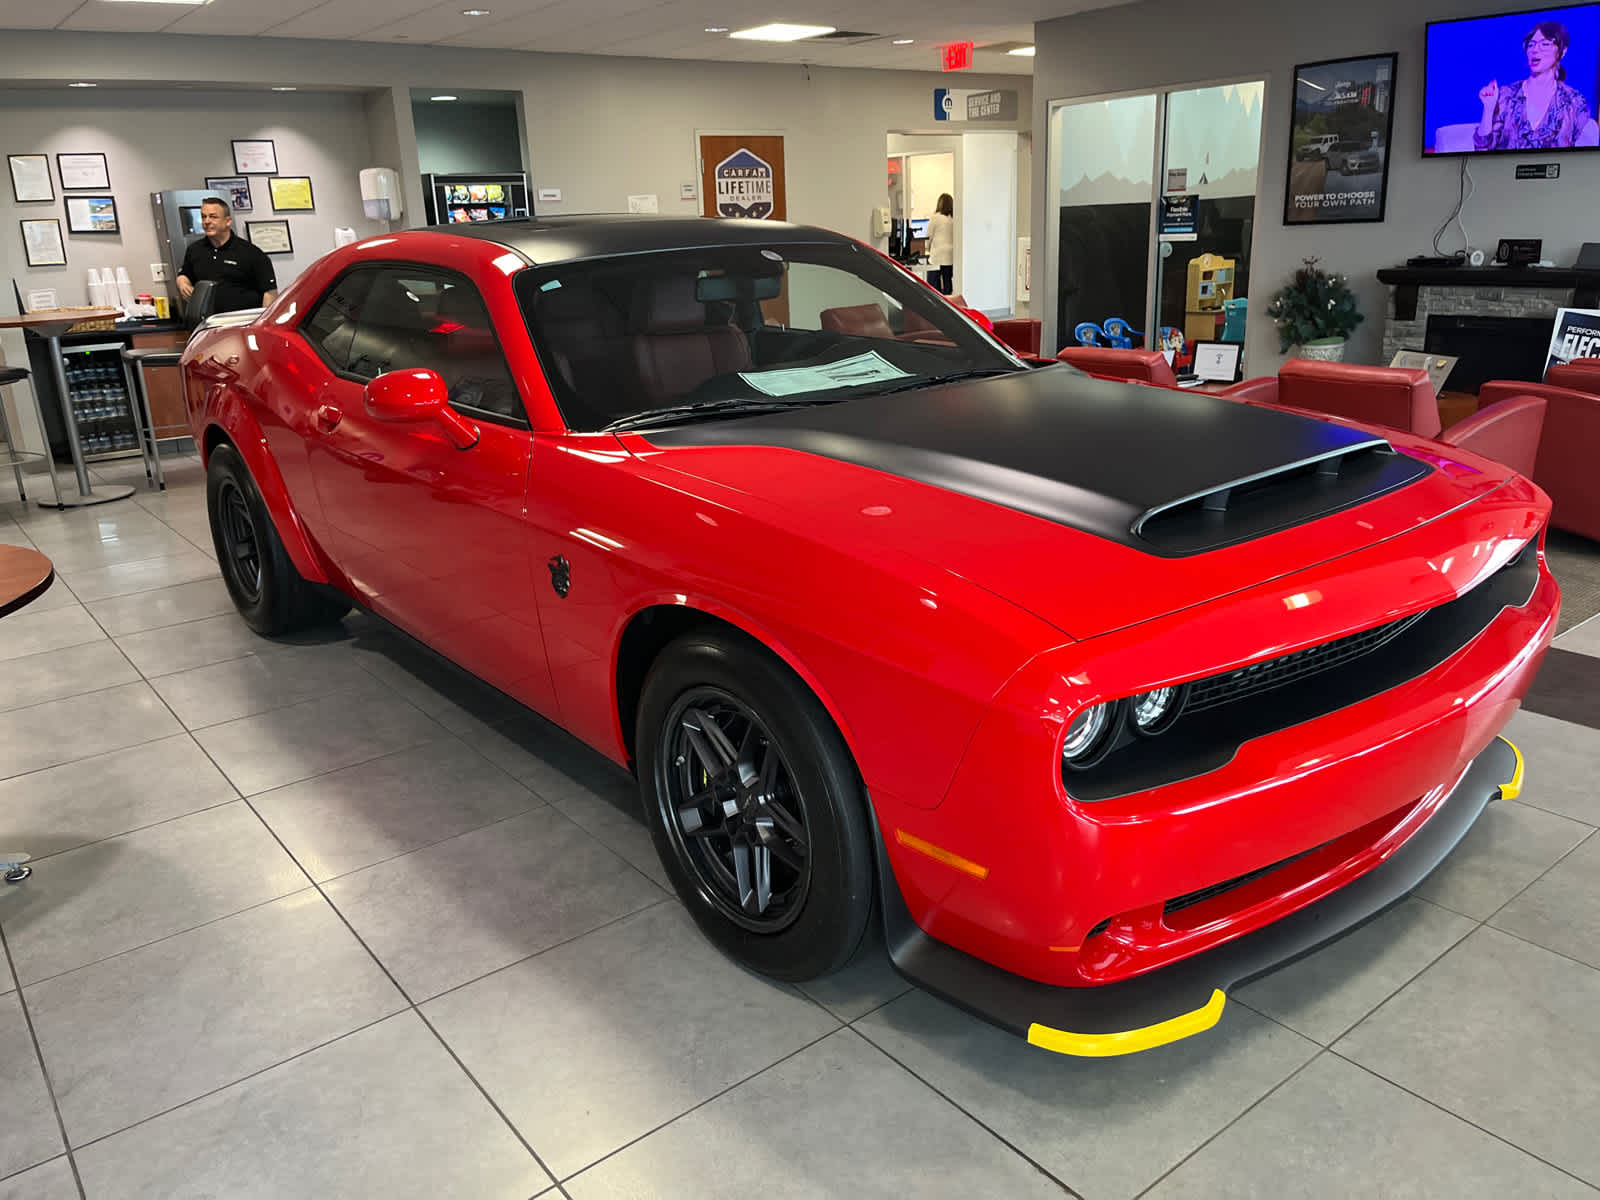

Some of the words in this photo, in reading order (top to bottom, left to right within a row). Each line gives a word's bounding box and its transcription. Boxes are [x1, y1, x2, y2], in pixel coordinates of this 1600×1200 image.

[947, 42, 968, 70] EXIT
[718, 181, 771, 194] LIFETIME
[1337, 191, 1376, 200] CHOOSE
[1350, 198, 1375, 206] PATH
[1560, 333, 1600, 361] ELEC
